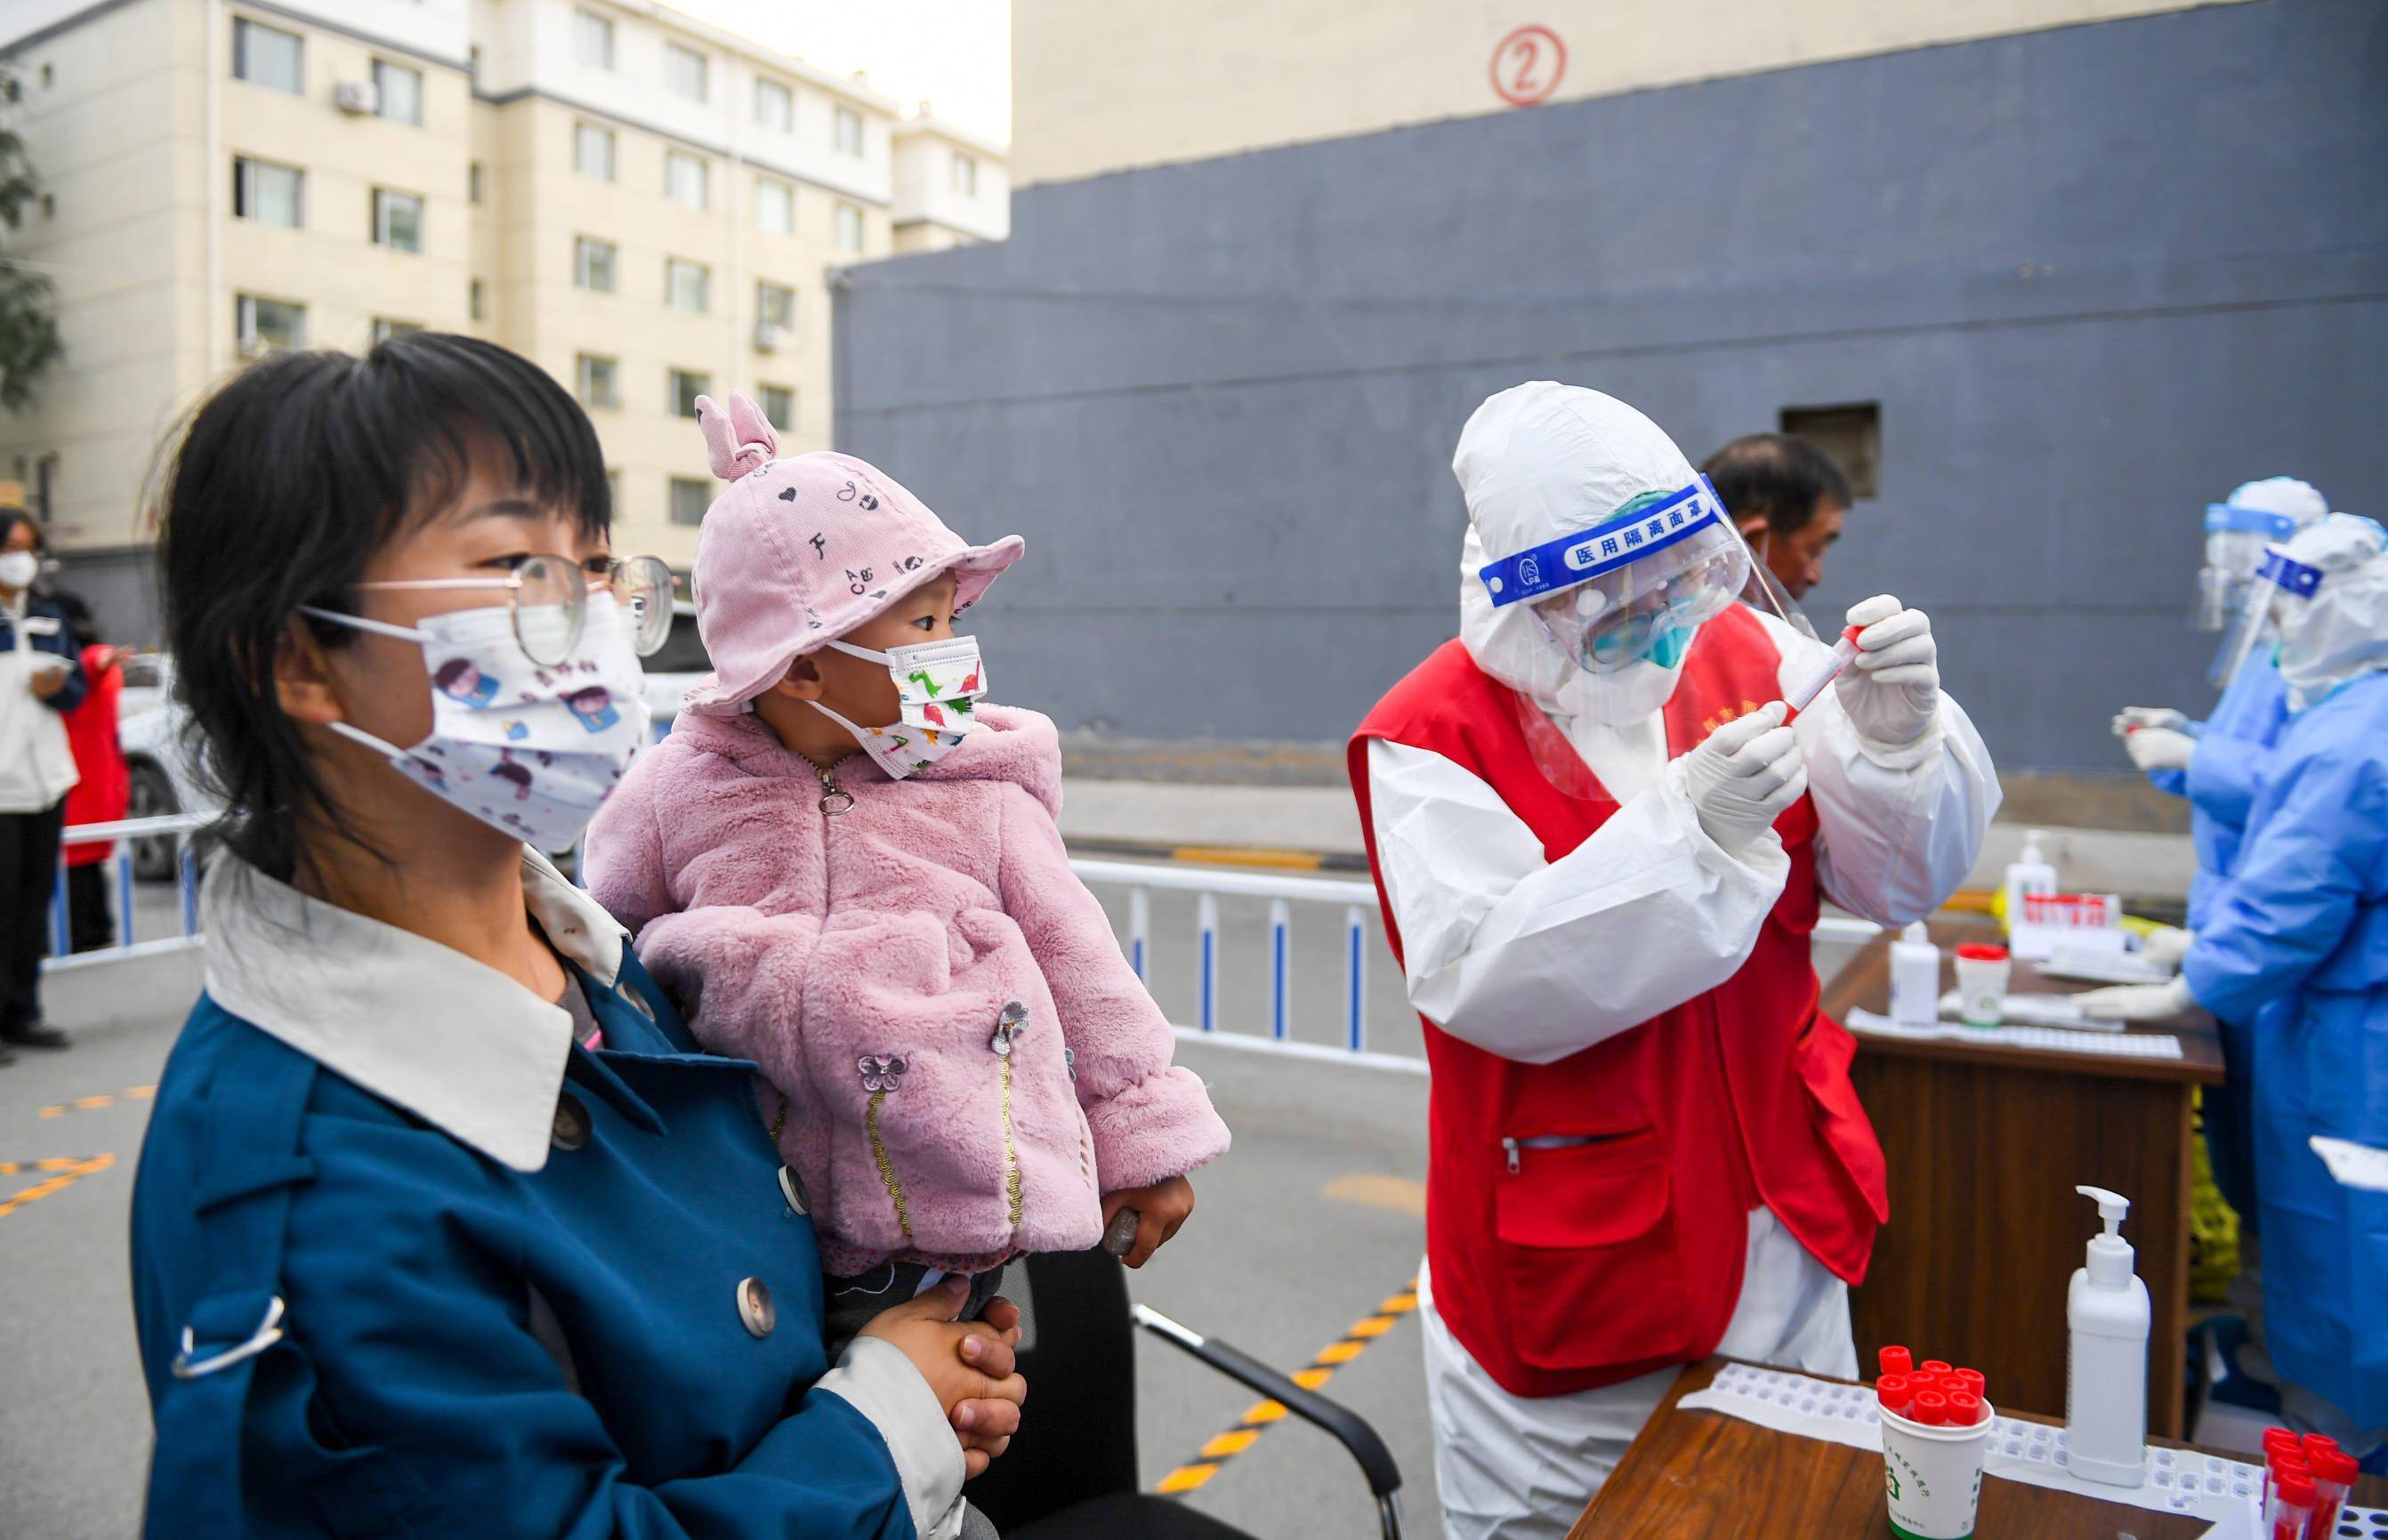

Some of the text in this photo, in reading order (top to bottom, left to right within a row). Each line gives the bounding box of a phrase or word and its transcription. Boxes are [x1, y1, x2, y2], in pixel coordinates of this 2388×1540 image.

[1576, 499, 1702, 565] 医用隔离面罩
